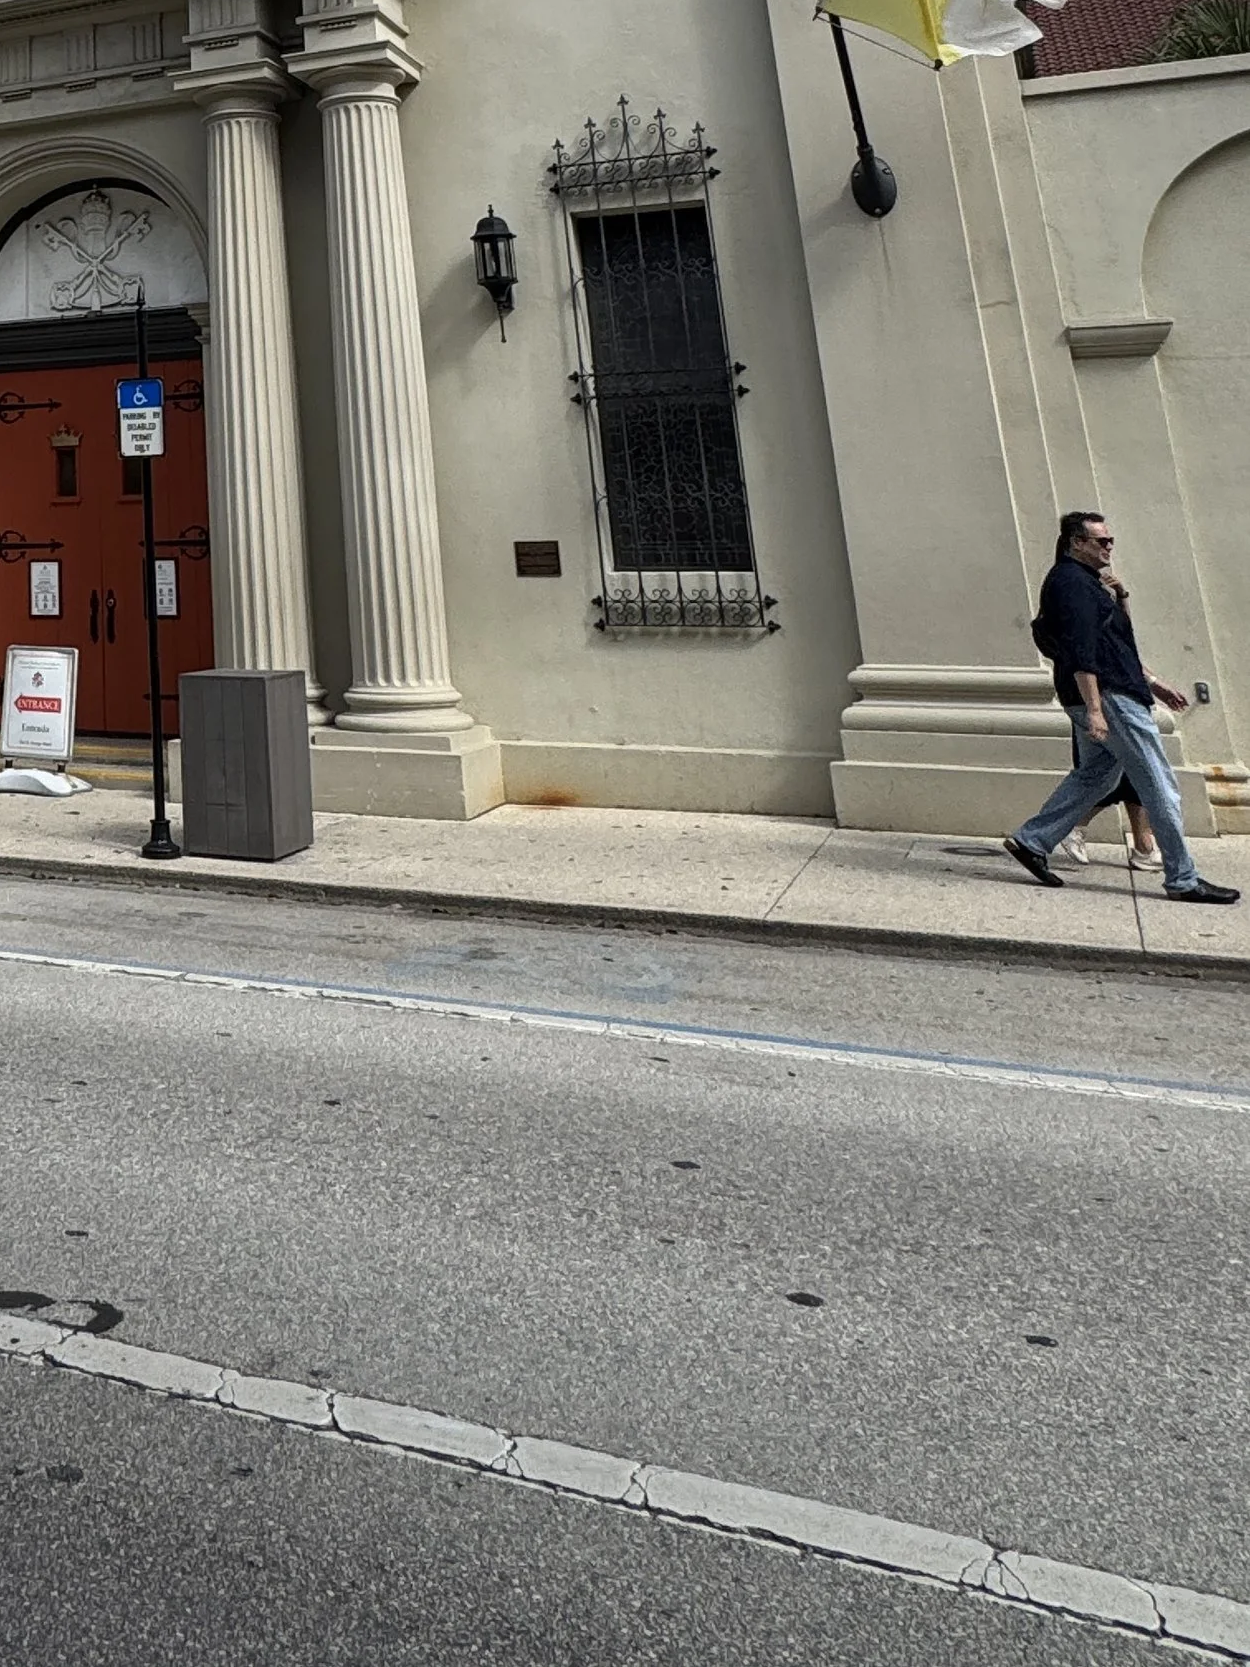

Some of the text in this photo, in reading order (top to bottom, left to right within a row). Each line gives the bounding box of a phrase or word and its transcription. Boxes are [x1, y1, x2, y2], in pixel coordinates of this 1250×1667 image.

[122, 411, 160, 420] PARKING BY
[127, 422, 156, 431] DISABLED
[131, 433, 153, 441] PERMIT
[134, 444, 150, 452] ONLY
[17, 698, 60, 711] ENTRANCE
[21, 723, 50, 733] Entrada
